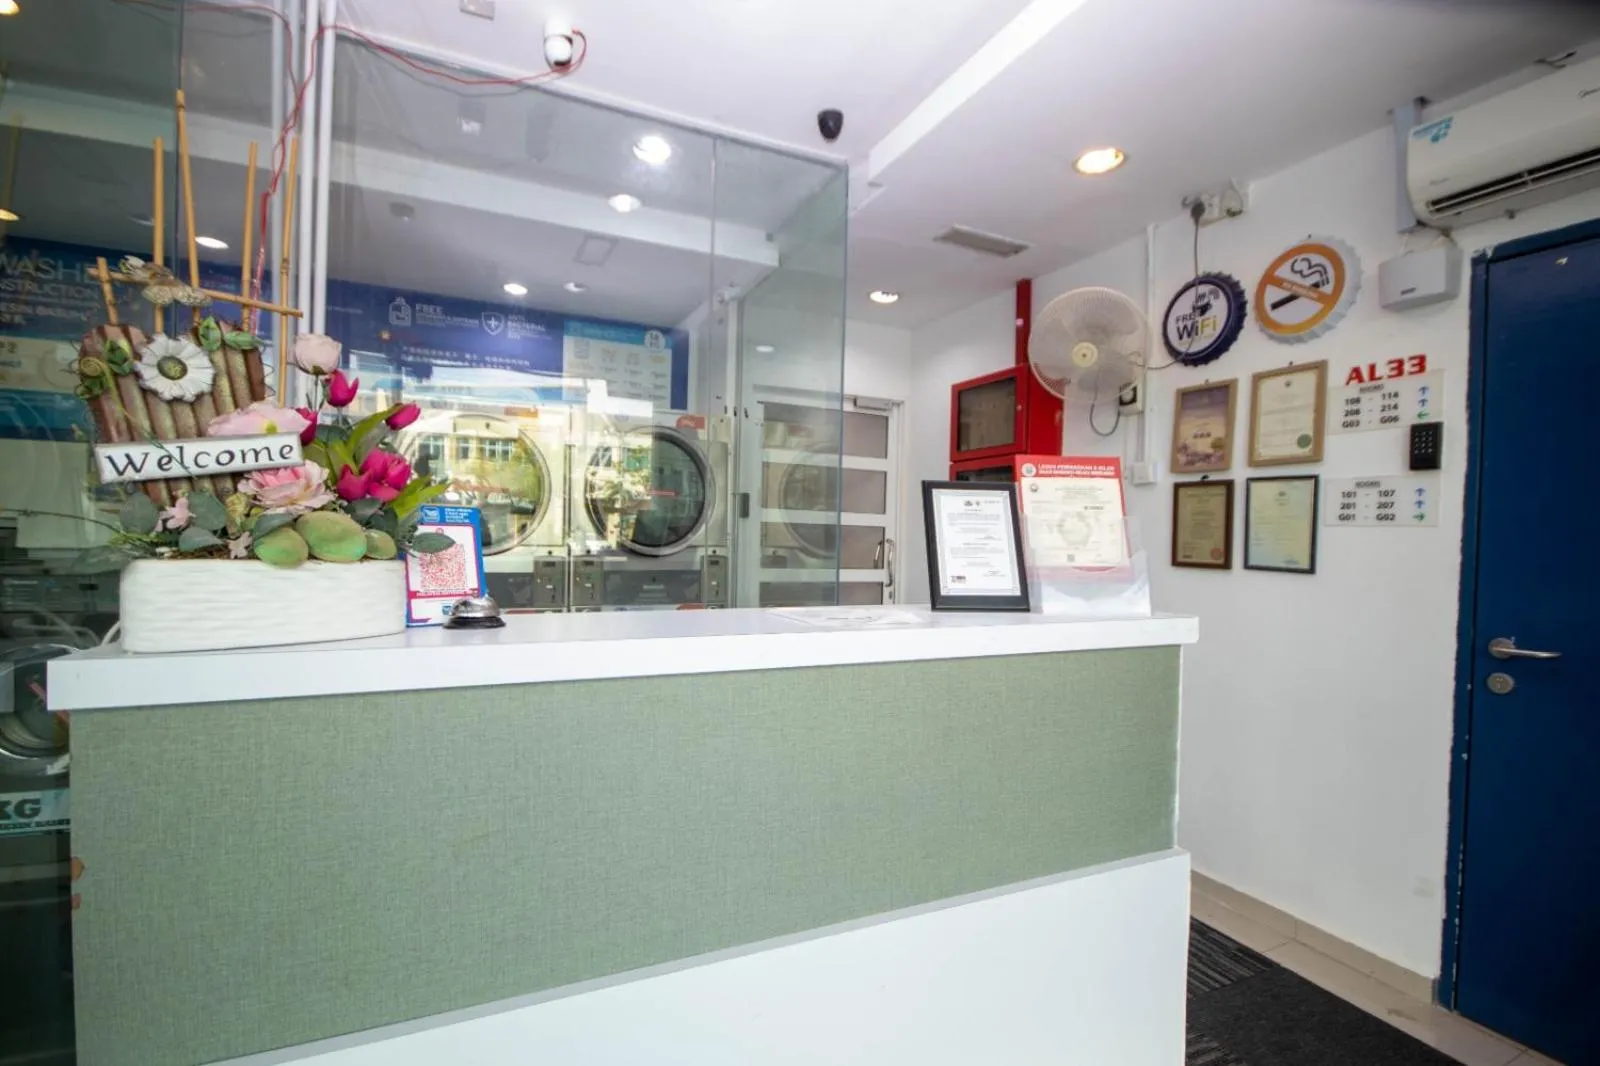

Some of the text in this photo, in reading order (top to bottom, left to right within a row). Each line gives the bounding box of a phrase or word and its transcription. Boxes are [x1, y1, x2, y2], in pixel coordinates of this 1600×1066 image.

[1345, 354, 1427, 386] AL33
[1382, 391, 1399, 401] 114
[1380, 403, 1399, 413] 214
[104, 443, 294, 477] Welcome
[1378, 489, 1396, 497] 107
[1340, 502, 1356, 510] 201
[1376, 501, 1395, 510] 207
[1338, 513, 1356, 521] G01
[1376, 513, 1396, 521] G02
